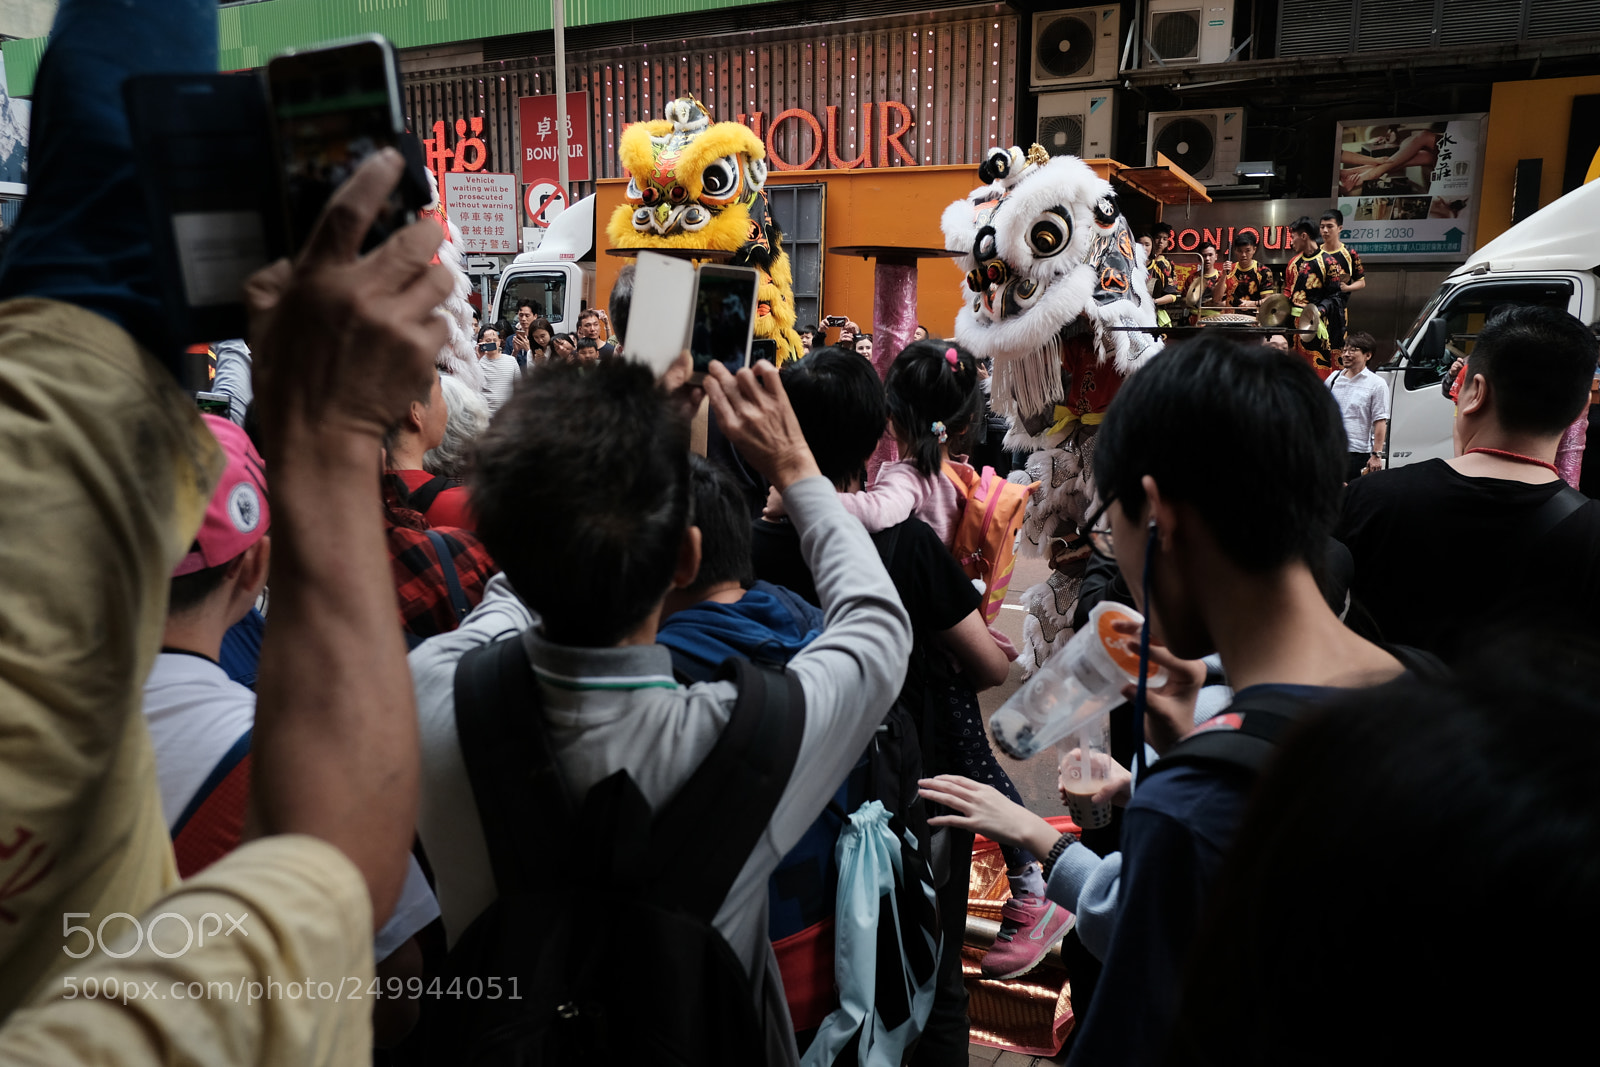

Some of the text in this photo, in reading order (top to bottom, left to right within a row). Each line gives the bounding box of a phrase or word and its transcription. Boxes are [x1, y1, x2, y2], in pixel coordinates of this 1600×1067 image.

[526, 144, 583, 161] BONJUR
[465, 176, 495, 184] Vehicle
[460, 212, 504, 222] 停車等候
[461, 225, 505, 236] 會被檢控
[1352, 227, 1414, 239] 2781 2030
[463, 239, 510, 249] 不予警告
